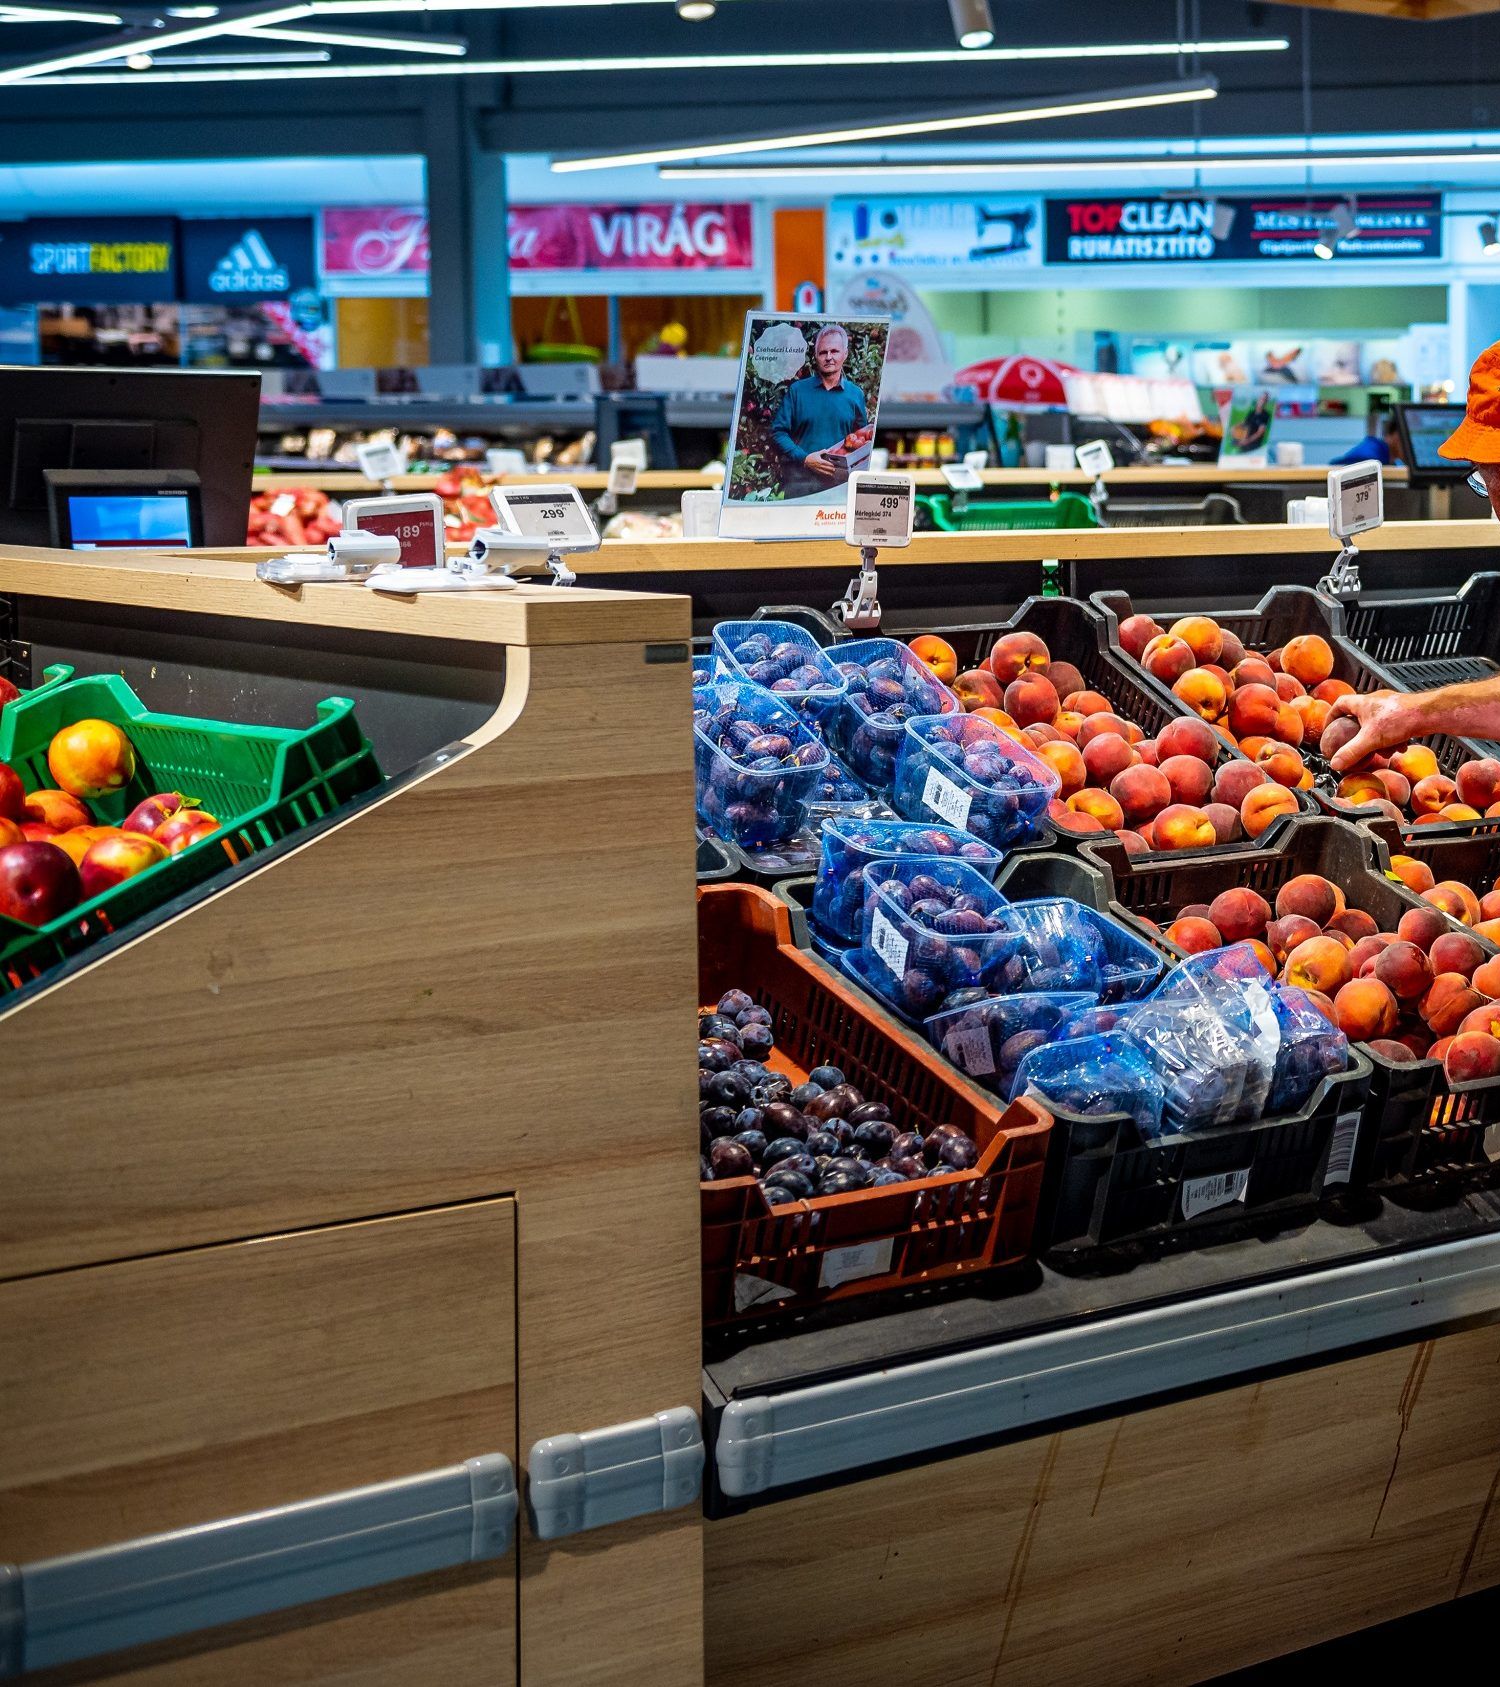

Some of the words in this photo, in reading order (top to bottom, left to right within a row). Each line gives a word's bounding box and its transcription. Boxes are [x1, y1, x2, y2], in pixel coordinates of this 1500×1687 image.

[589, 203, 729, 258] VIRÁG
[207, 266, 290, 292] adidas
[785, 346, 805, 354] László
[754, 354, 778, 362] Csenger
[1355, 490, 1369, 503] 379
[879, 497, 899, 509] 499
[540, 508, 565, 519] 299
[815, 509, 847, 520] Aucha
[394, 525, 420, 539] 189
